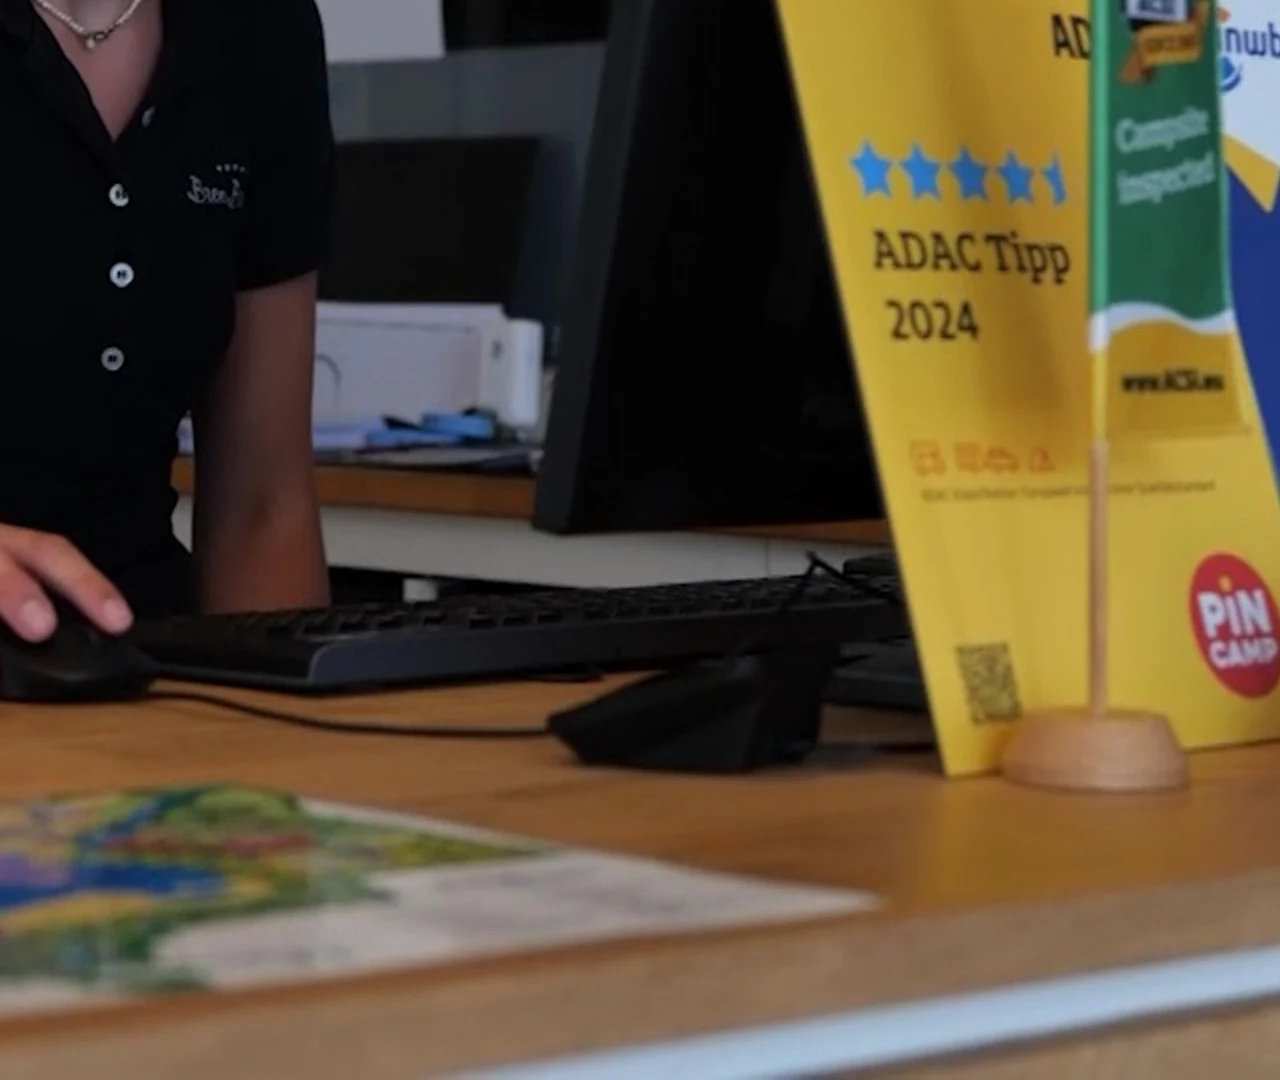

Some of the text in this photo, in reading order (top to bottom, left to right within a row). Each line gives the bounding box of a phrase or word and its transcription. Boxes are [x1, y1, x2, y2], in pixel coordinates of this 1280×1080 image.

[1115, 106, 1210, 154] Campsite
[874, 229, 1070, 285] ADAC Tipp
[885, 299, 979, 341] 2024
[1209, 636, 1279, 669] CAMP
